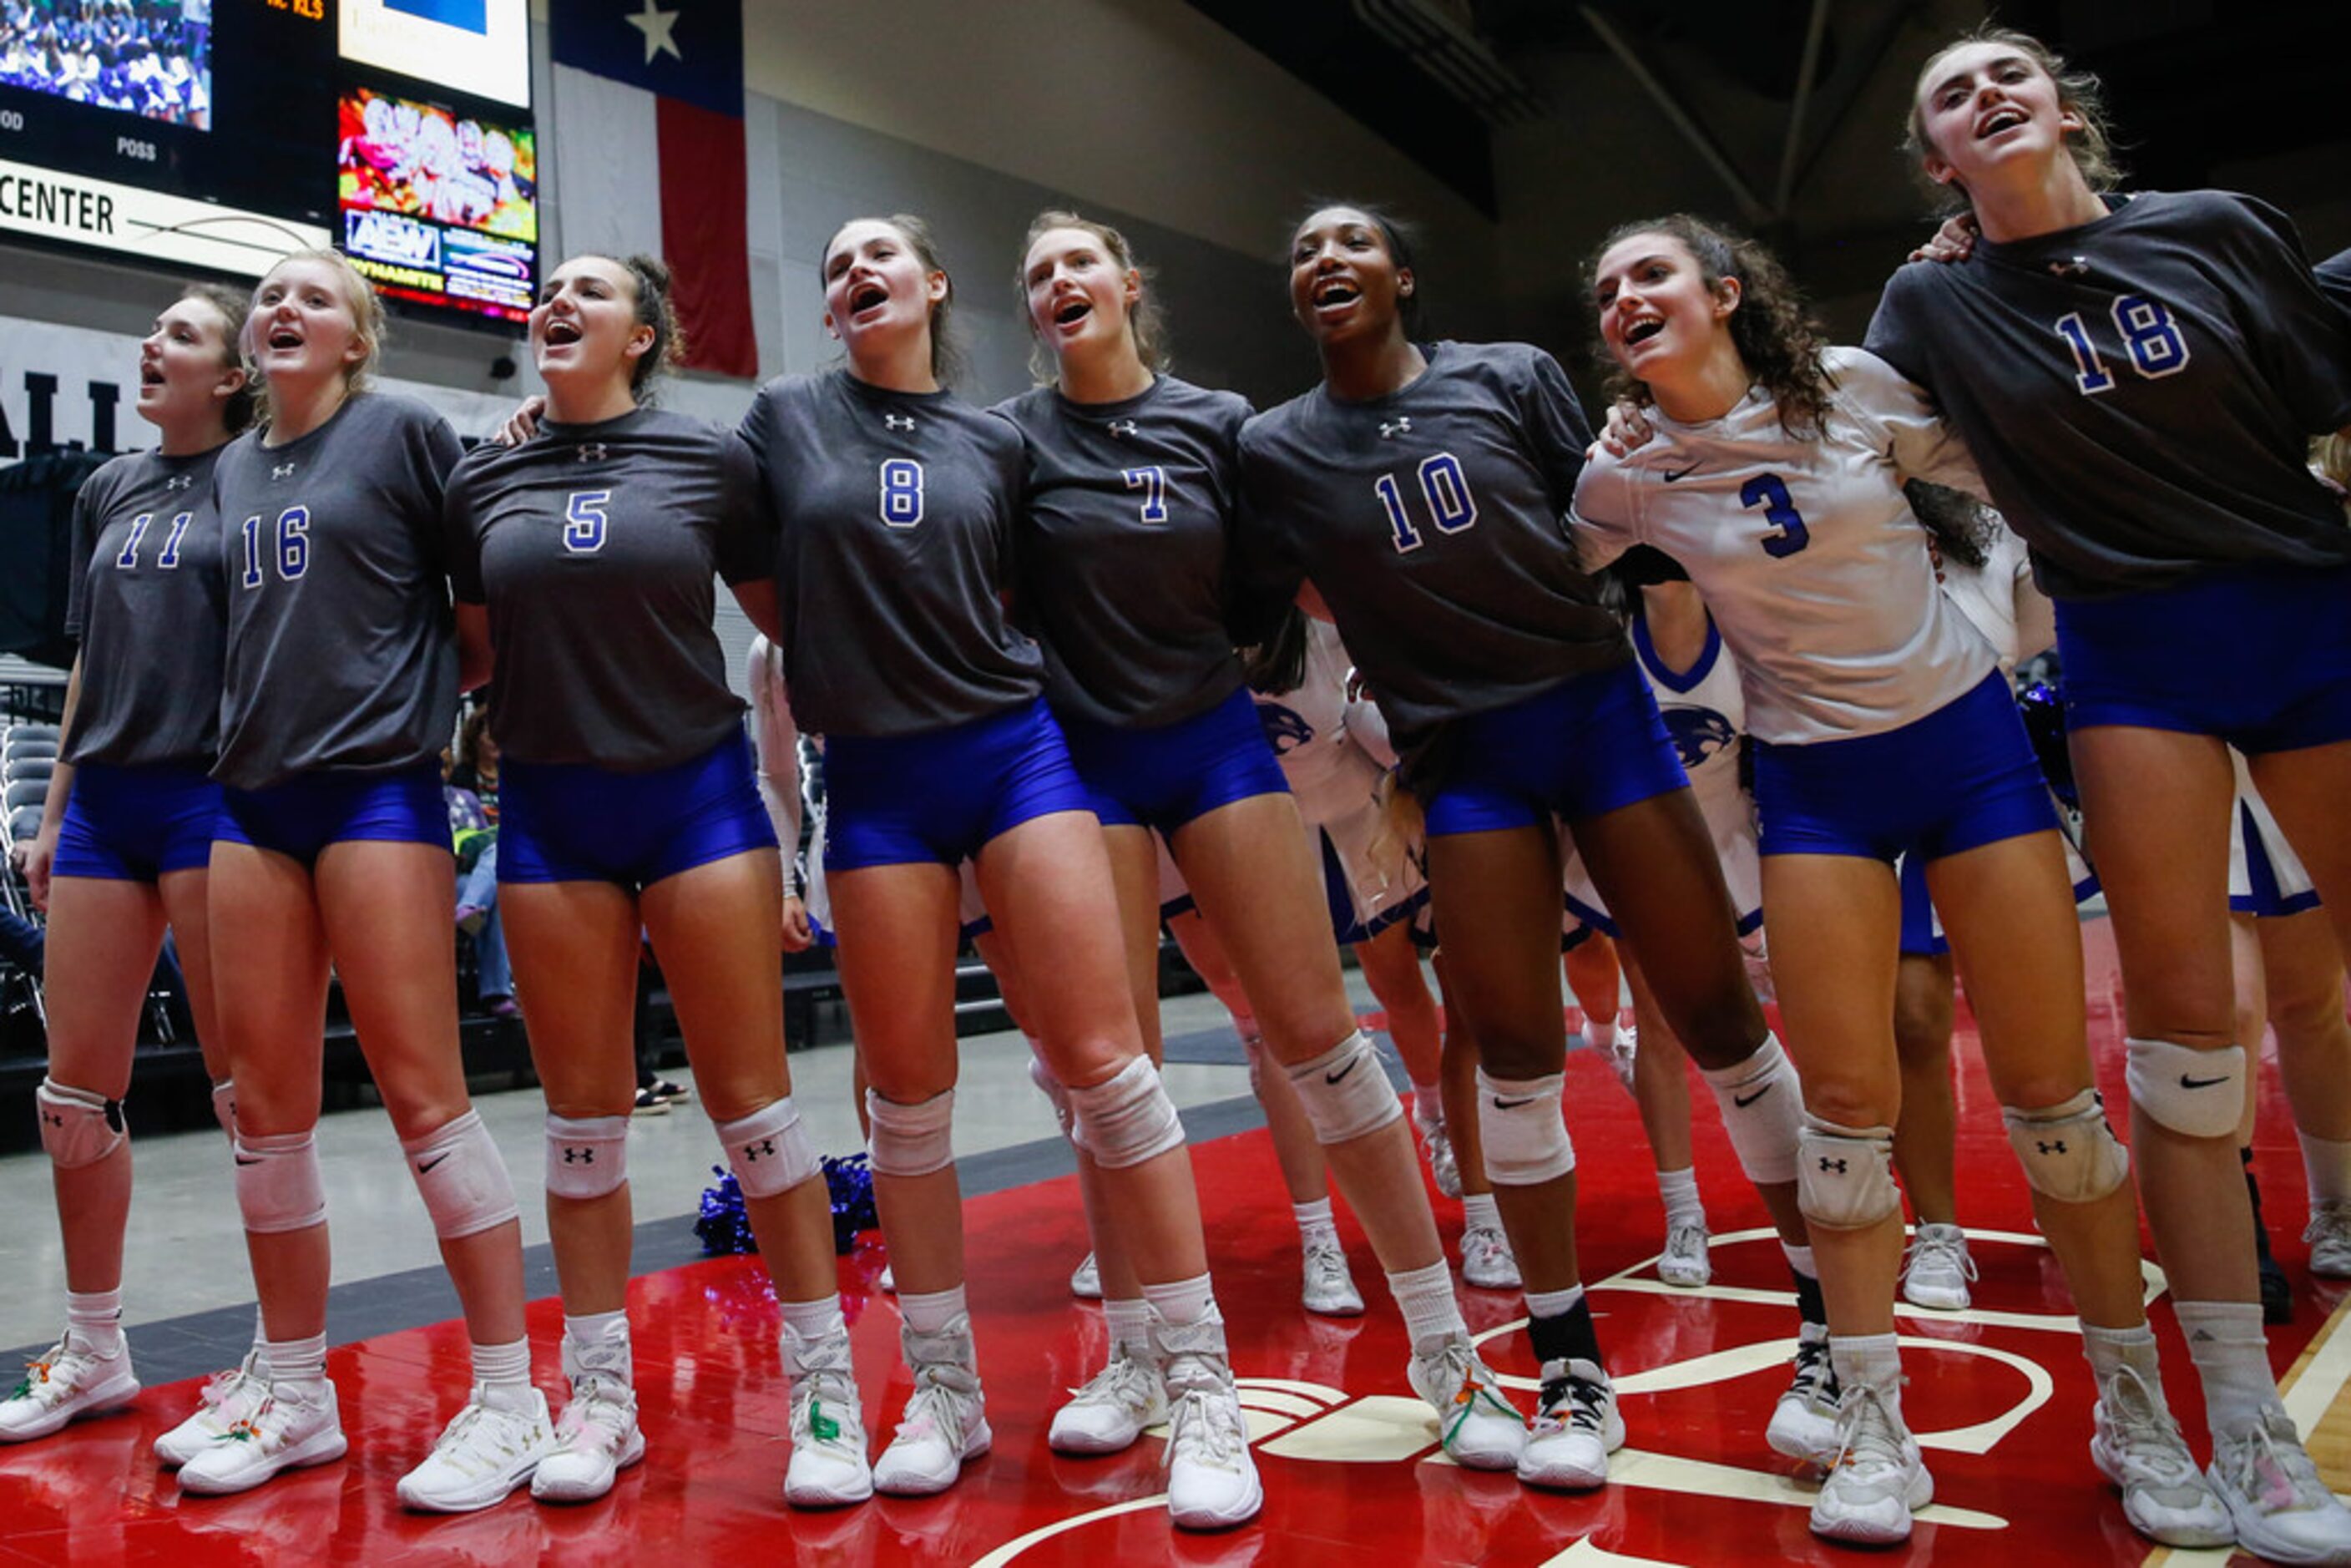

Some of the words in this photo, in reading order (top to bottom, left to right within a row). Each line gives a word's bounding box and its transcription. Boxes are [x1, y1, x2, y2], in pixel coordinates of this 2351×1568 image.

[117, 137, 156, 161] POSS
[0, 175, 114, 235] CENTER
[2055, 295, 2191, 396] 18
[563, 490, 612, 551] 5
[880, 458, 924, 528] 8
[1120, 465, 1167, 524] 7
[1374, 452, 1478, 554] 10
[1740, 473, 1810, 559] 3
[116, 511, 194, 569] 11
[242, 504, 311, 588] 16
